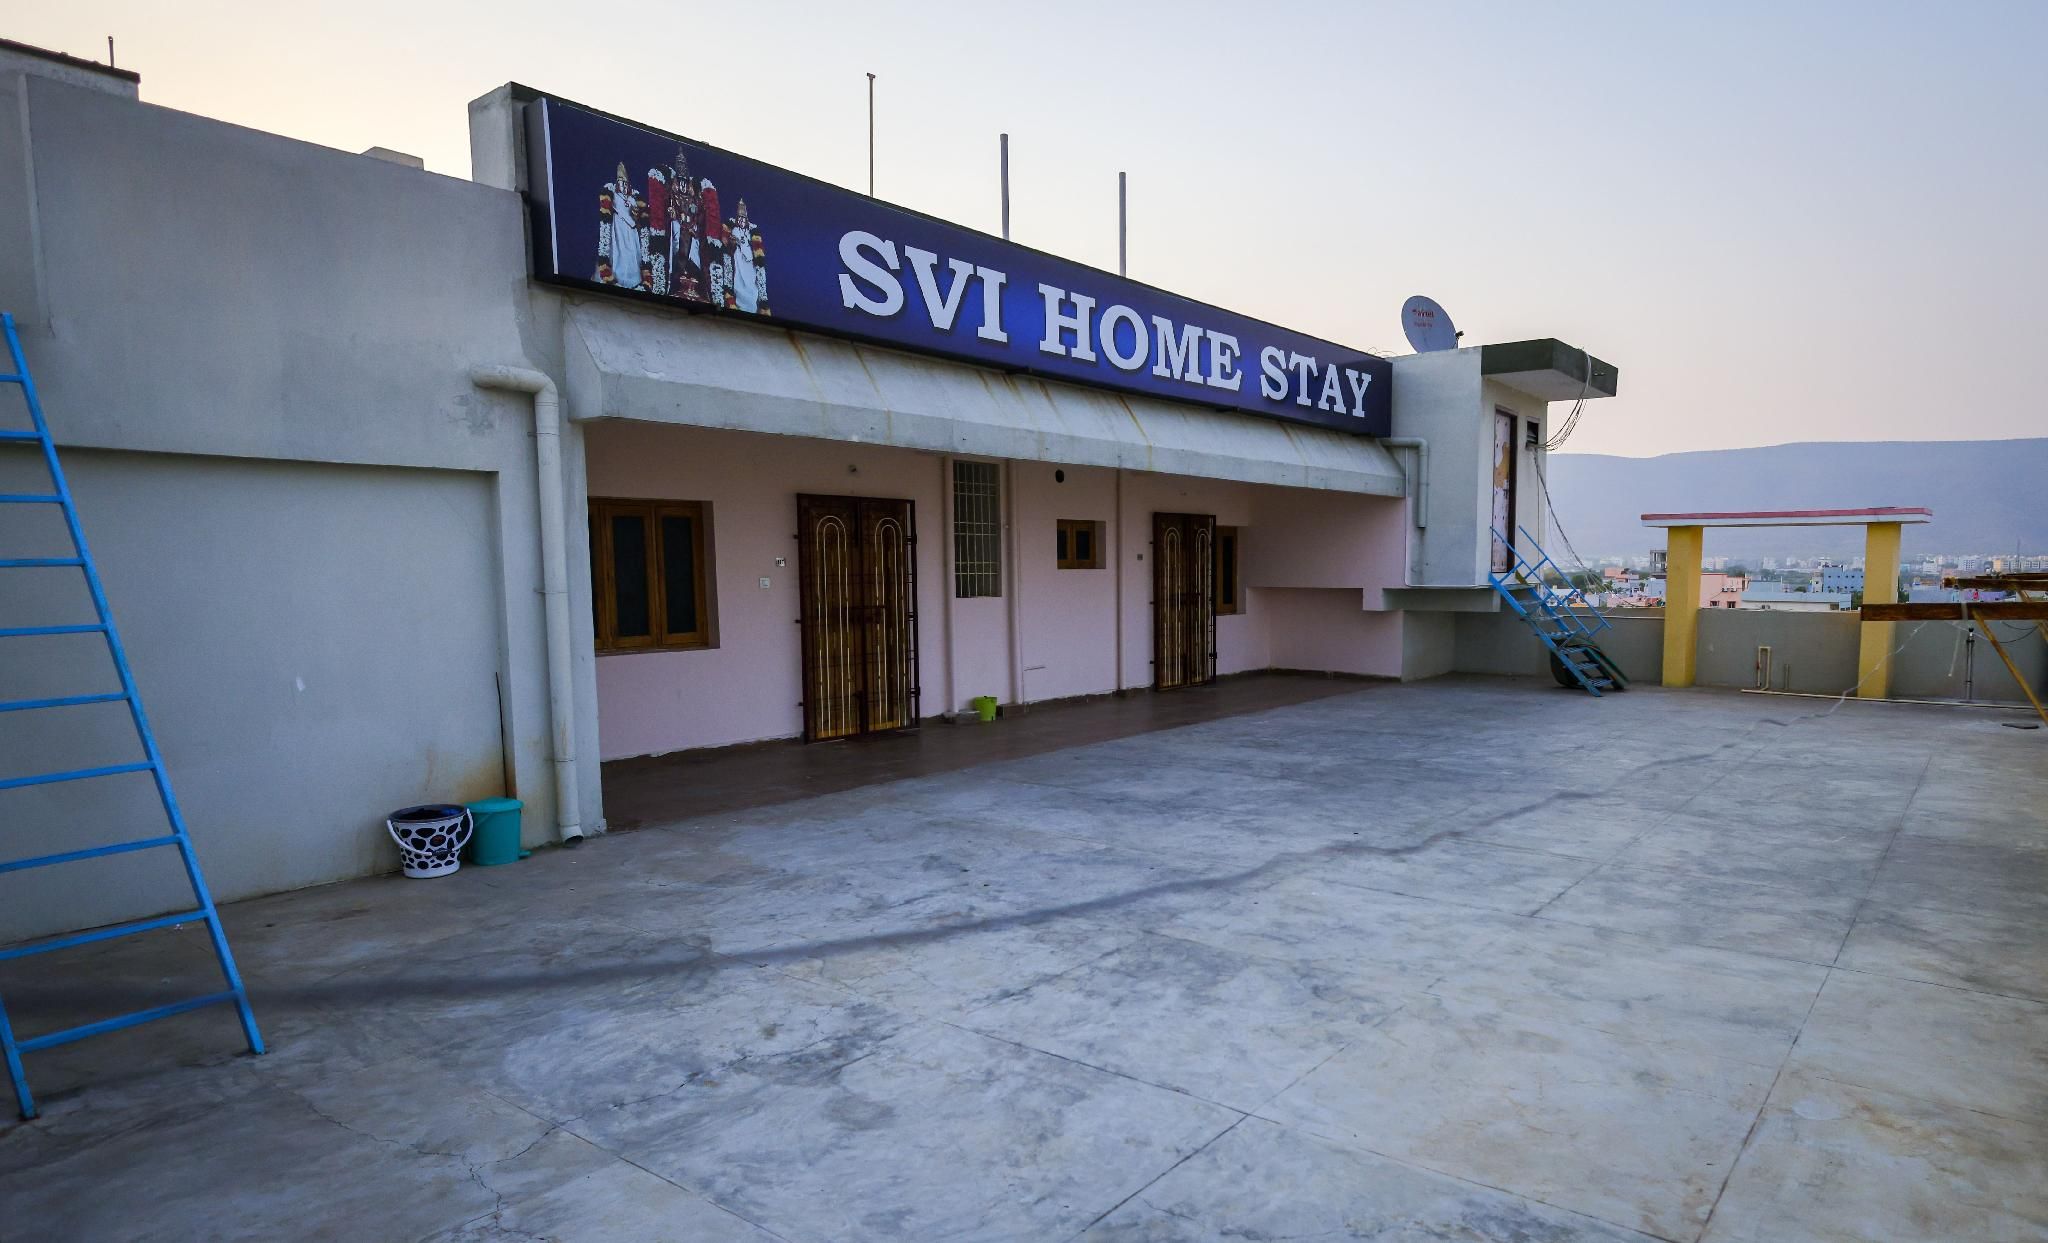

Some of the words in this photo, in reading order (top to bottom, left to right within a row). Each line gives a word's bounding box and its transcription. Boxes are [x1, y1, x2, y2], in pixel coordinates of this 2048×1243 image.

[838, 231, 1008, 343] SVI
[1038, 283, 1243, 391] HOME
[1259, 346, 1372, 418] STAY
